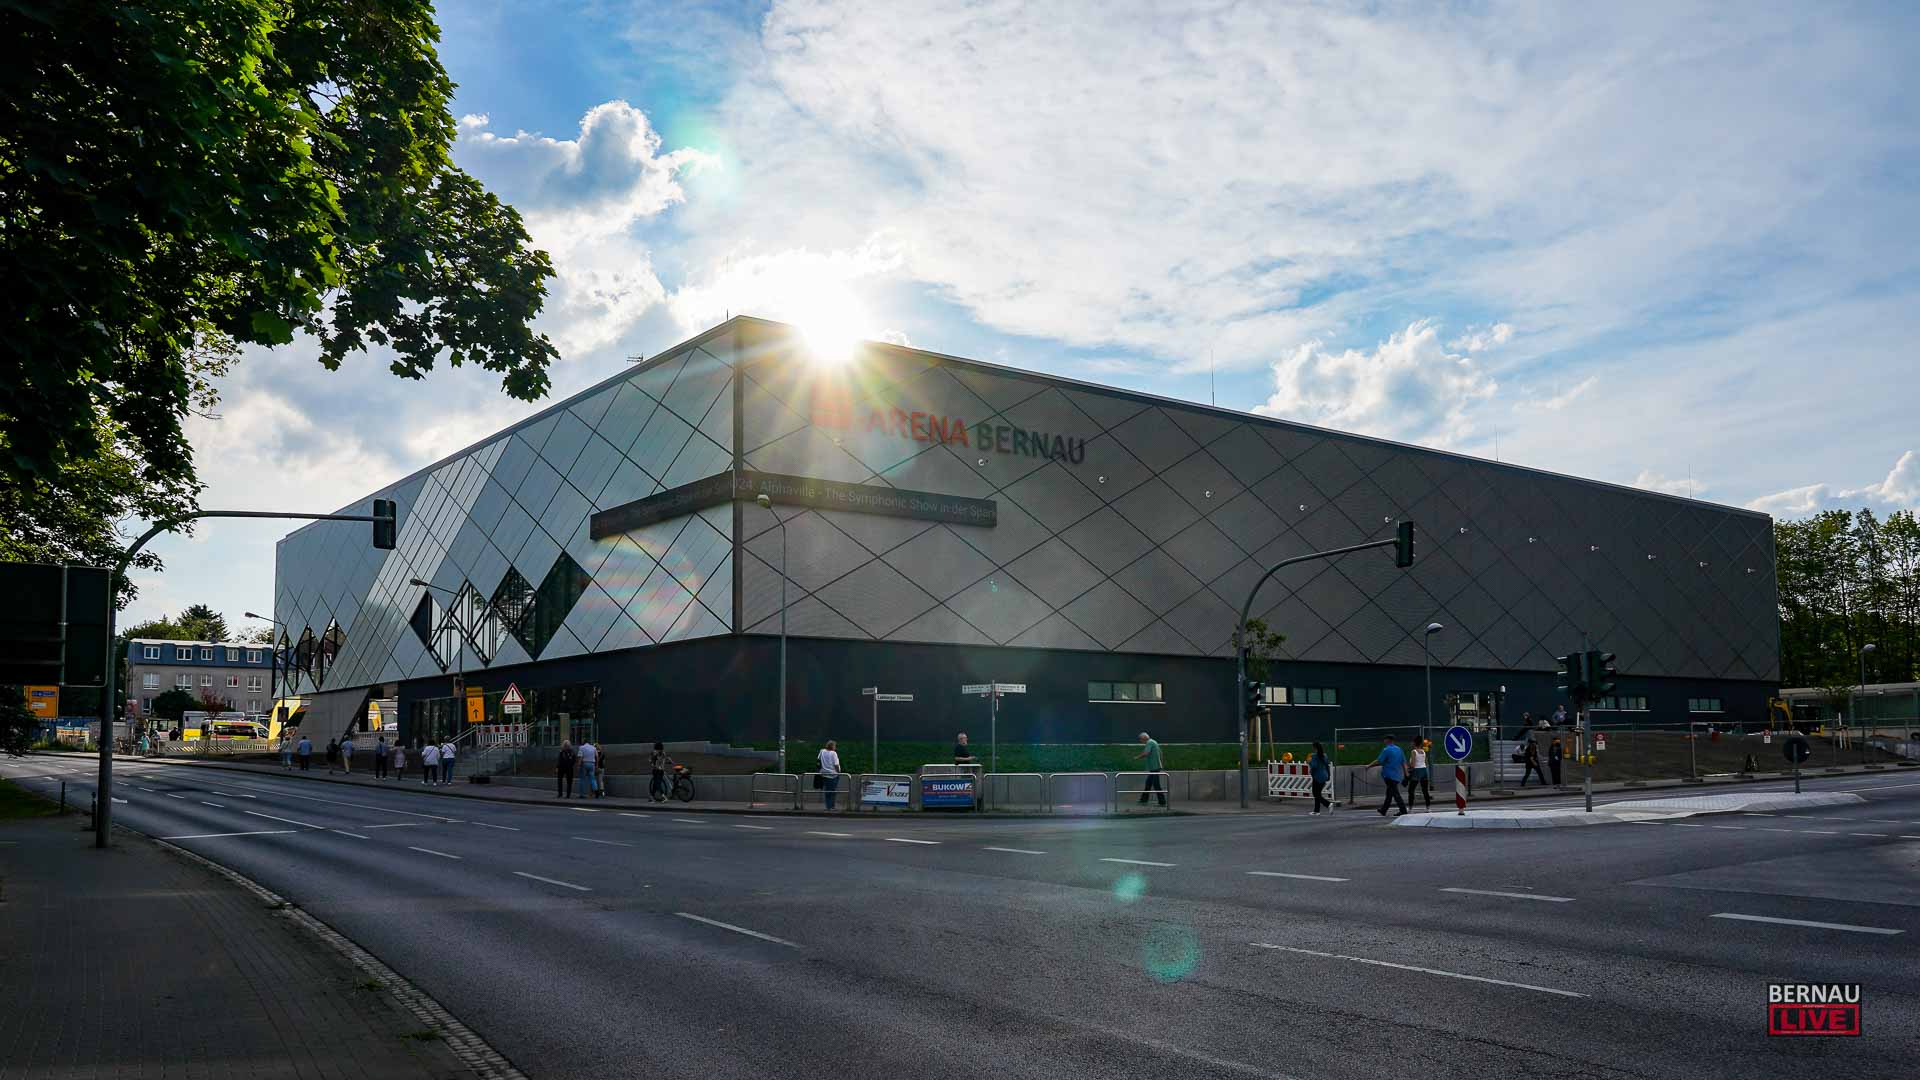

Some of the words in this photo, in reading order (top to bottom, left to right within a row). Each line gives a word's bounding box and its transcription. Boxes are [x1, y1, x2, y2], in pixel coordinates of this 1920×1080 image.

[866, 407, 970, 449] ARENA
[977, 423, 1086, 465] BERNAU
[824, 486, 847, 502] The
[848, 489, 906, 509] Symphonic
[910, 496, 938, 513] Show
